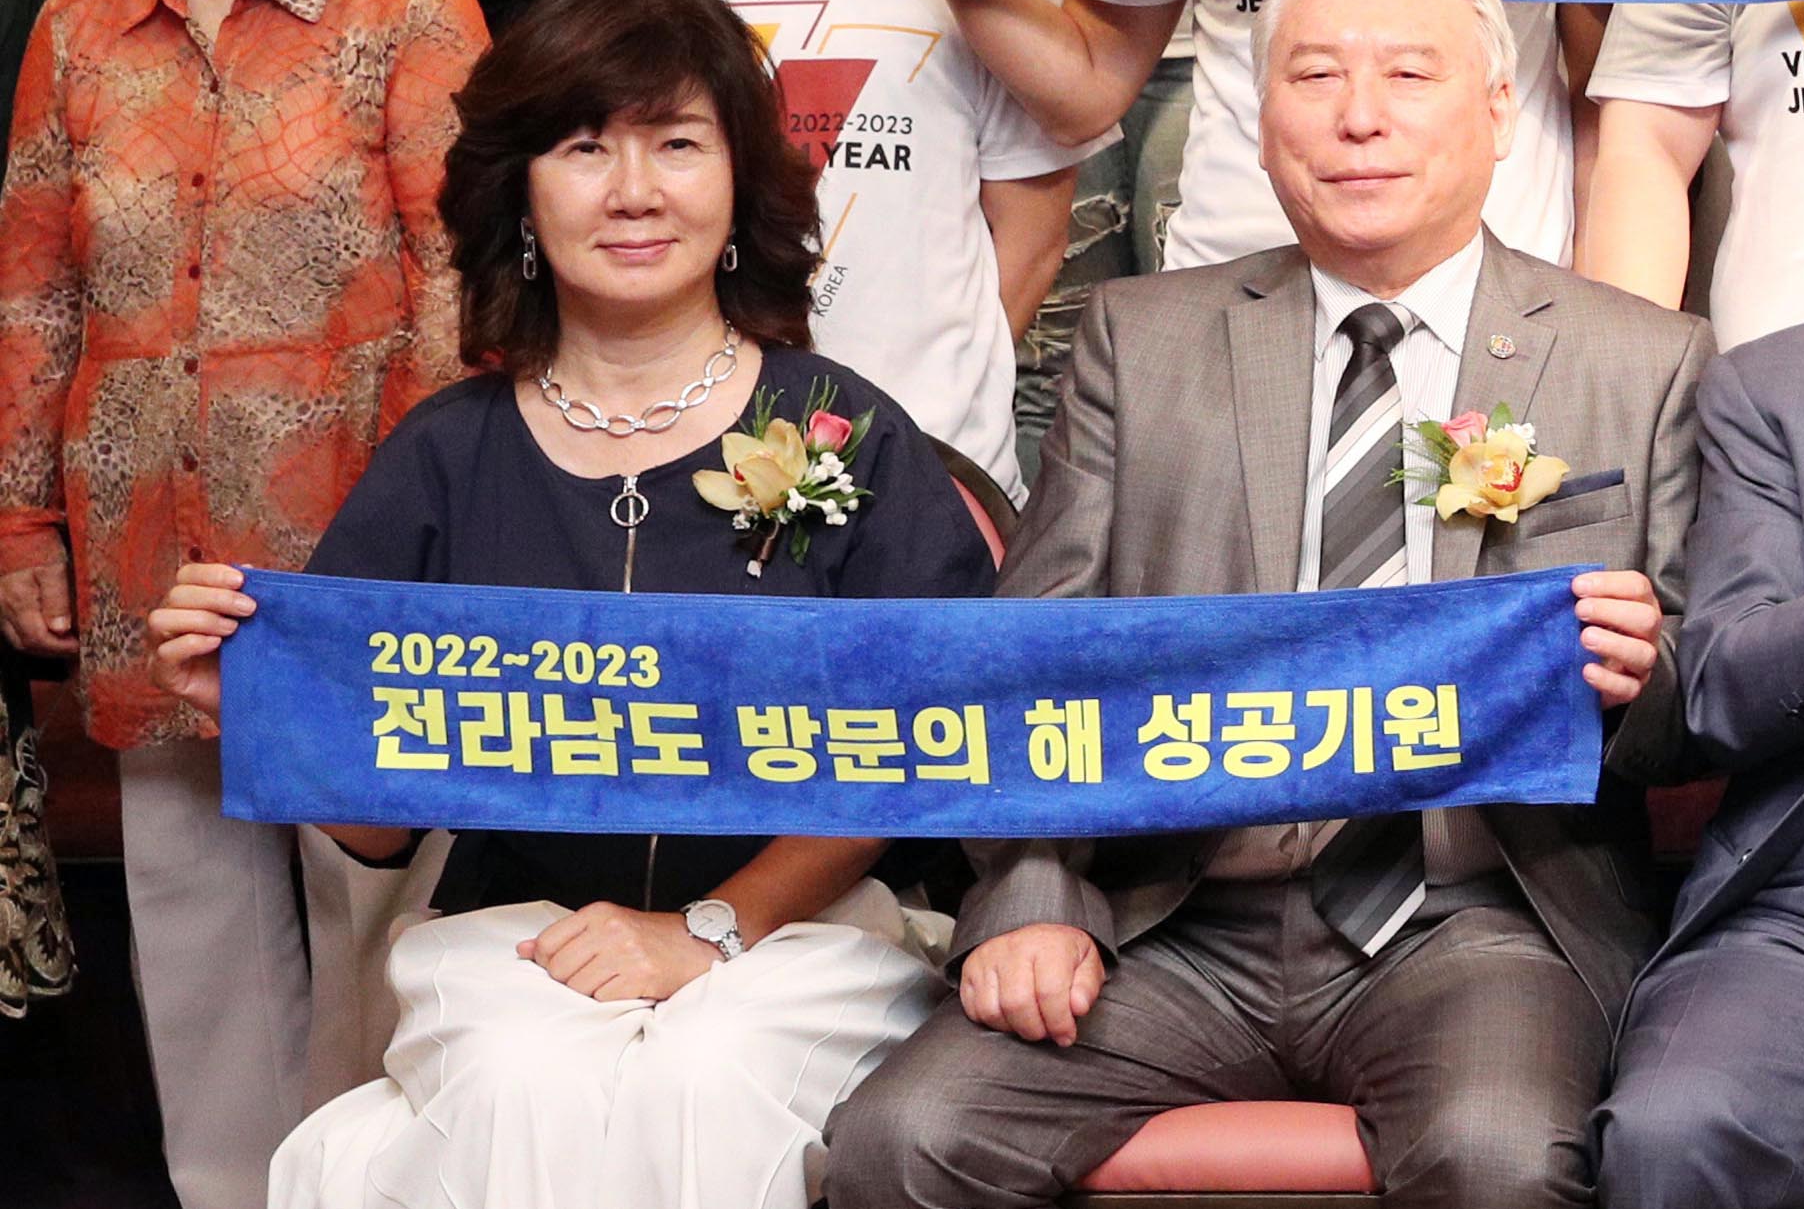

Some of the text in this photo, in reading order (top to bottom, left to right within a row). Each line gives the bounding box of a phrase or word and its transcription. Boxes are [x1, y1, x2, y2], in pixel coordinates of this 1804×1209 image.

[790, 113, 913, 135] 2022-2023
[823, 141, 912, 172] YEAR
[811, 265, 848, 317] KOREA
[369, 631, 660, 688] 2022~2023
[372, 684, 1461, 784] 전라남도 방문의 해 성공기원
